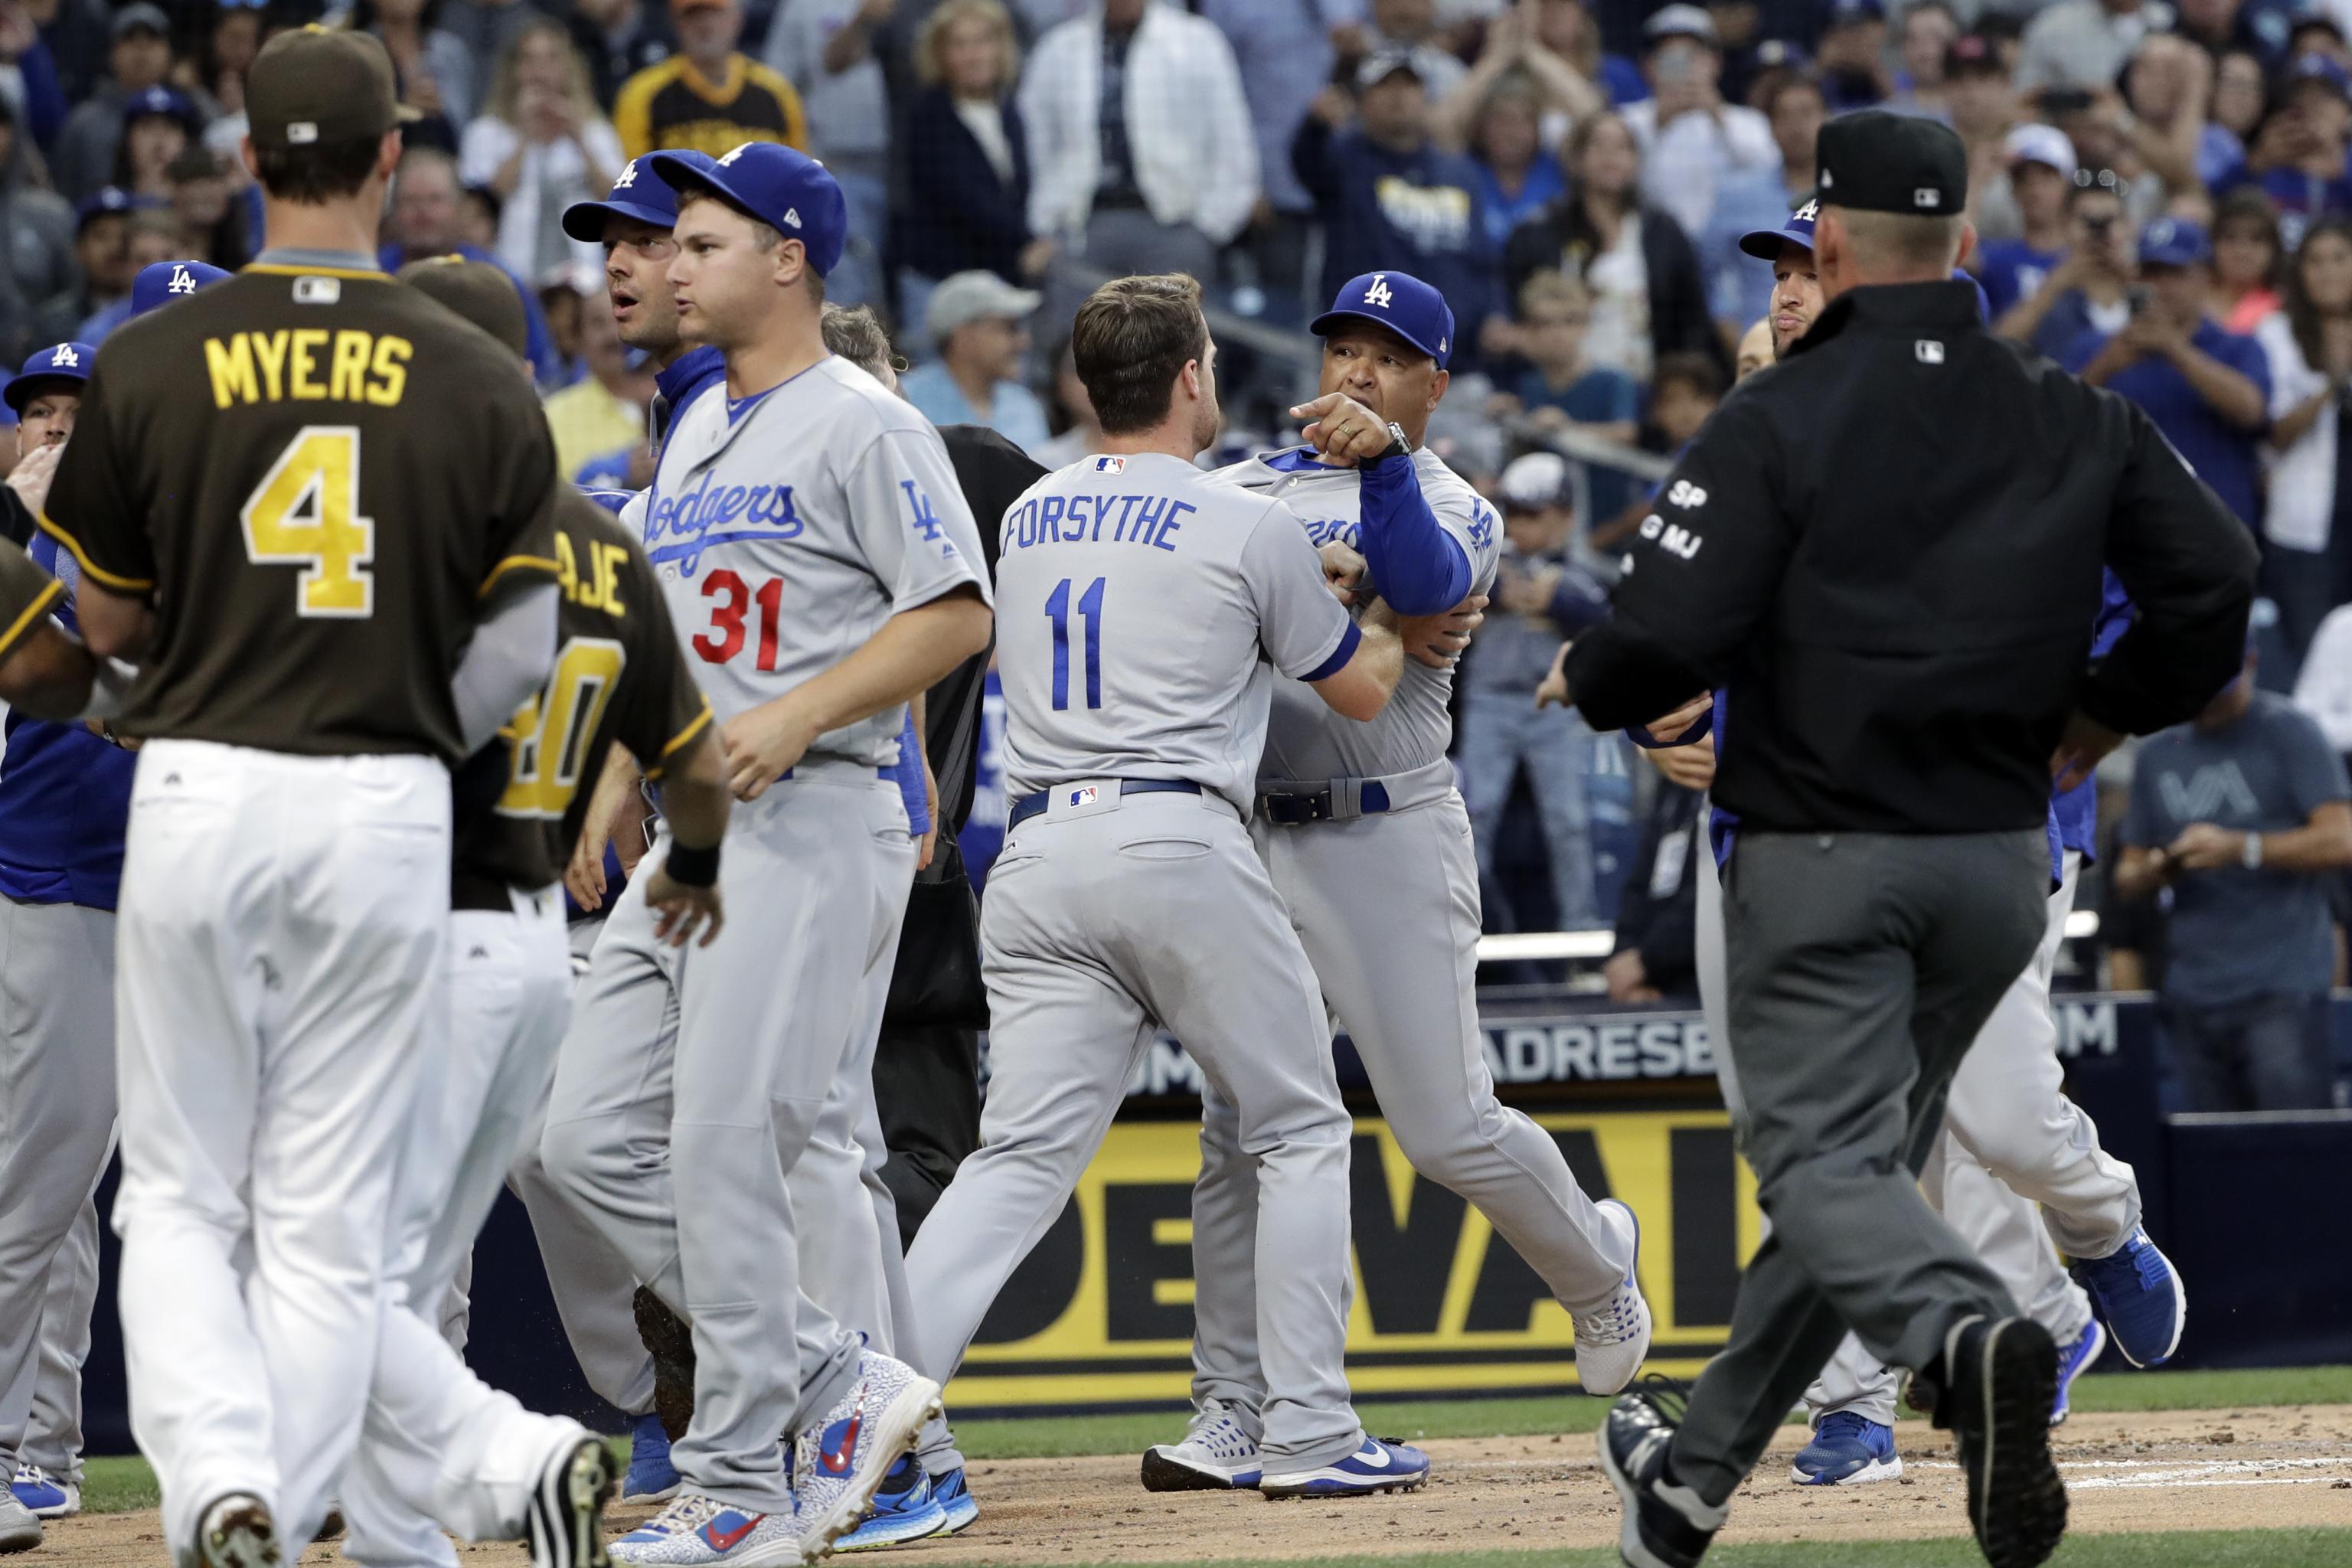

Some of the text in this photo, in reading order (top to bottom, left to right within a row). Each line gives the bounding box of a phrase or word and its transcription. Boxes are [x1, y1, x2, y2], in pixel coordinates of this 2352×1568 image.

[168, 264, 196, 294] LA
[1364, 274, 1393, 308] LA
[51, 342, 78, 368] LA
[204, 328, 414, 410] MYERS
[240, 425, 374, 619] 4
[644, 469, 802, 578] odgers
[900, 479, 942, 542] LA
[1467, 495, 1494, 550] LA
[1668, 479, 1707, 510] SP
[1001, 495, 1197, 558] FORSYTHE
[692, 567, 784, 672] 31
[1044, 577, 1106, 711] 11
